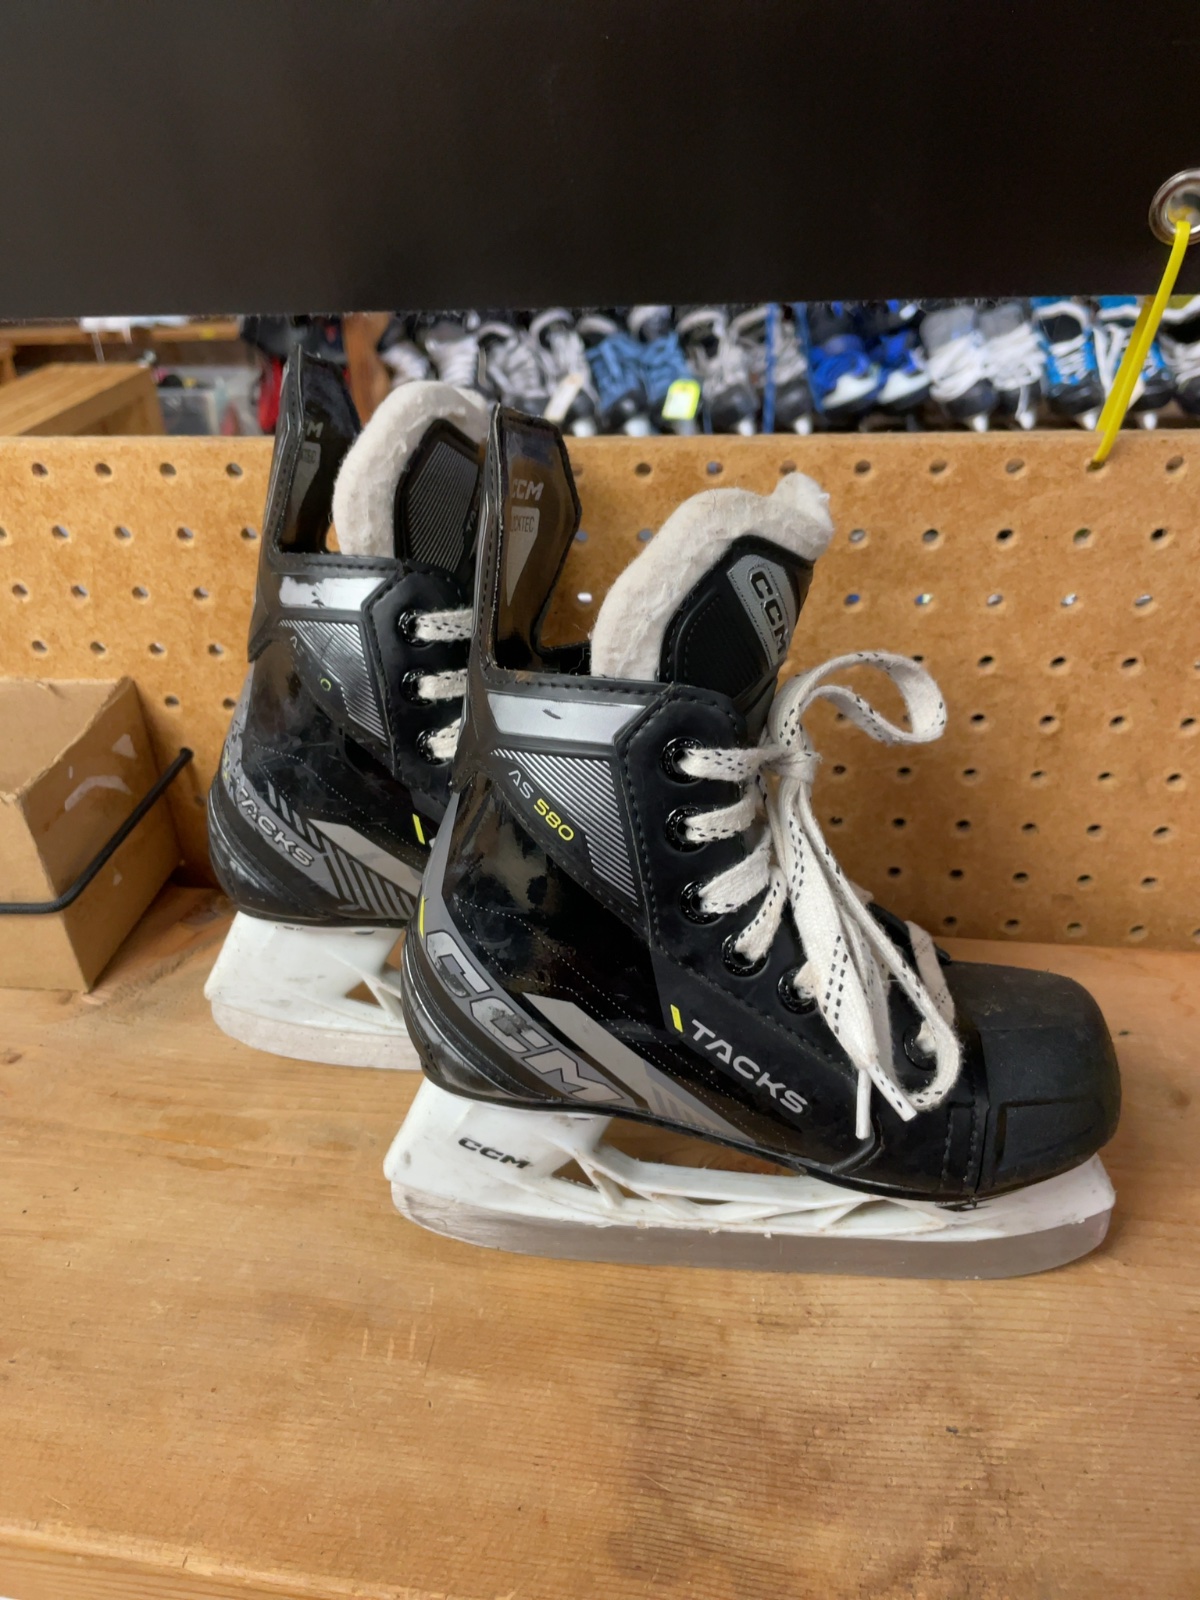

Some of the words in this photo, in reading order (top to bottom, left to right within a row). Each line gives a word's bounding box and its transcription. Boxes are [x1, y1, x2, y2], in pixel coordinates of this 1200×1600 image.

[750, 570, 788, 655] CCM
[508, 769, 534, 799] AS
[533, 798, 574, 841] 580
[426, 930, 625, 1101] CCM
[691, 1018, 808, 1114] TACKS
[457, 1137, 531, 1169] CCM
